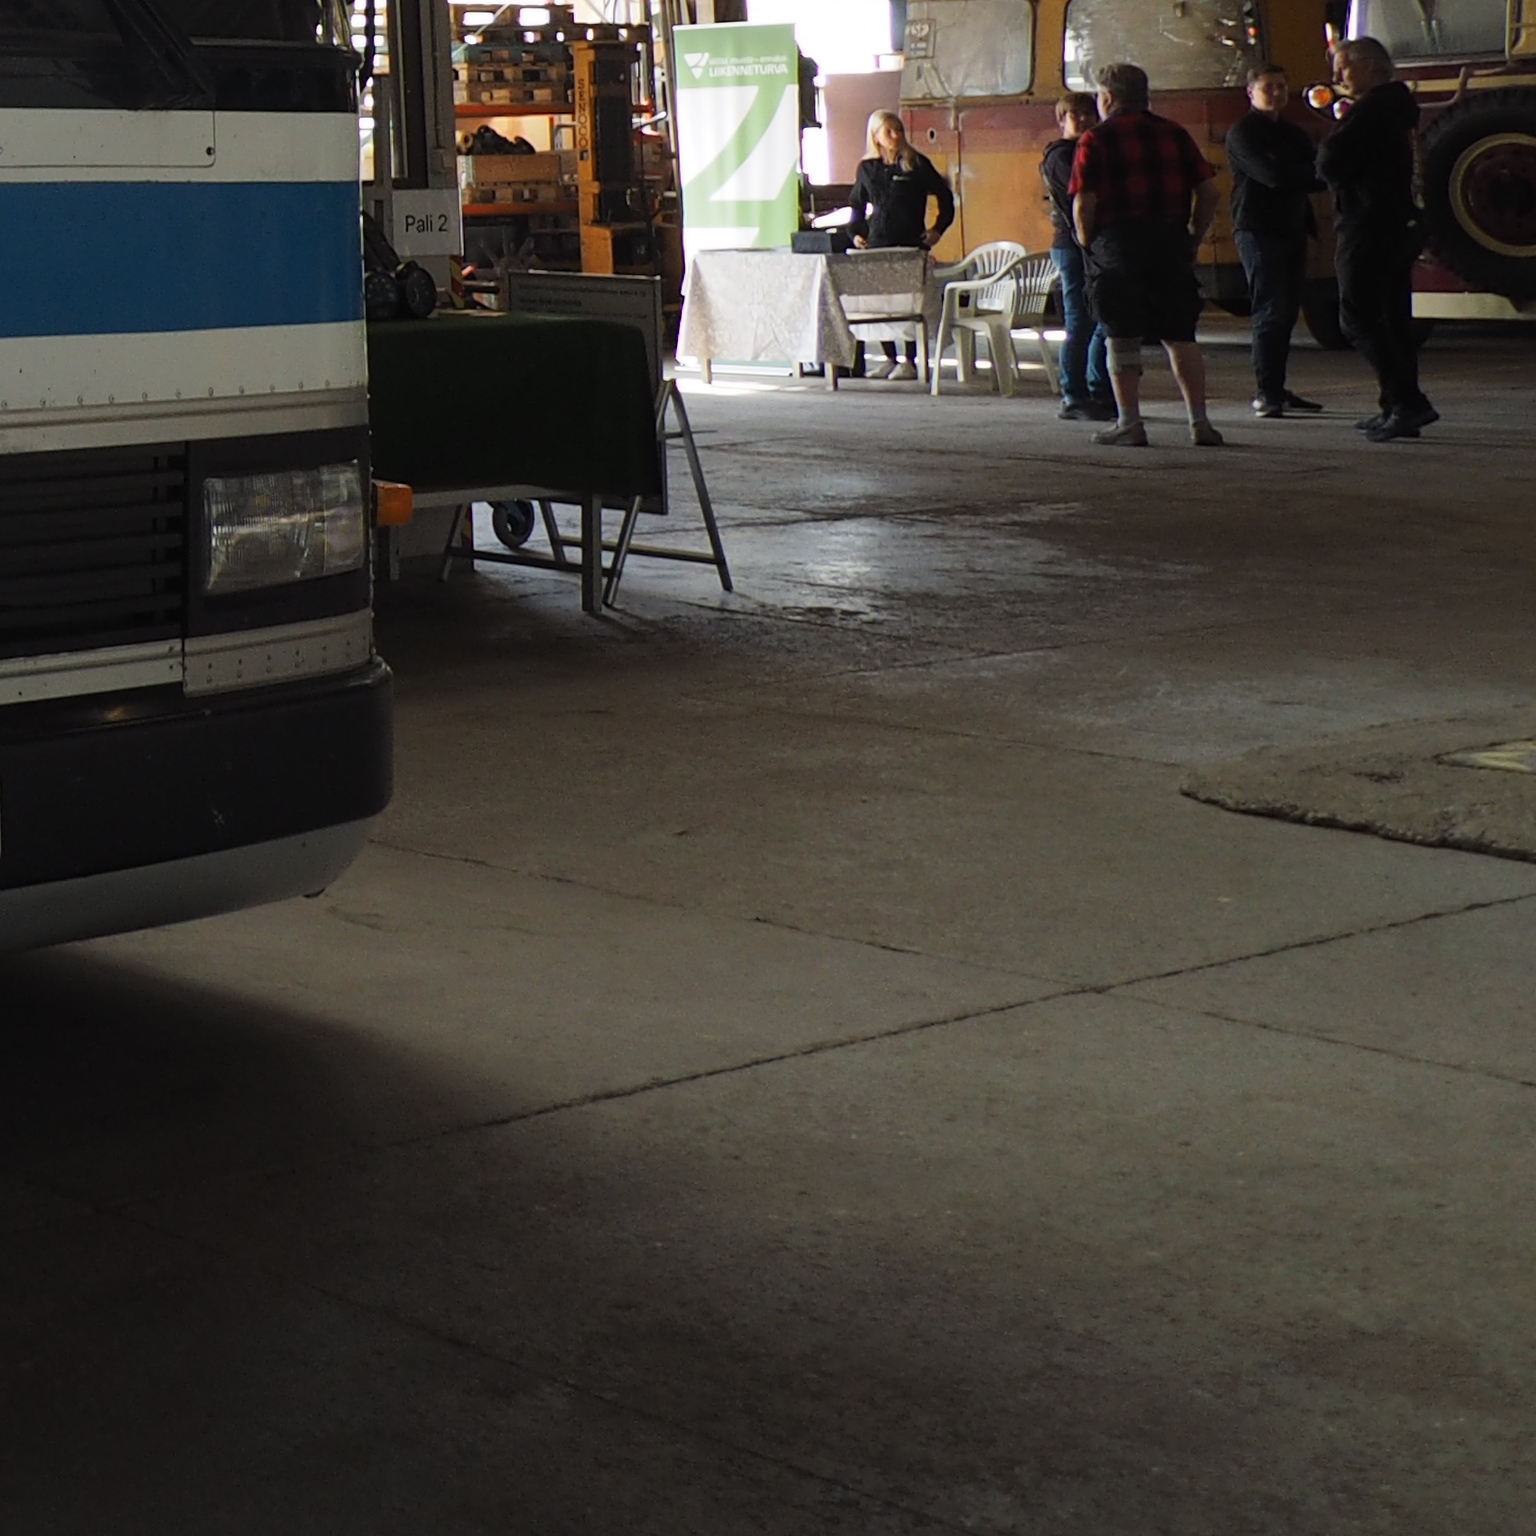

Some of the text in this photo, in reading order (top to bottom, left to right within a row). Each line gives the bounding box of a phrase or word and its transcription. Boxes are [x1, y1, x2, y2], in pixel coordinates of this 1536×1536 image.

[708, 63, 788, 78] LIIKENNETURVA
[405, 214, 448, 233] Pali 2
